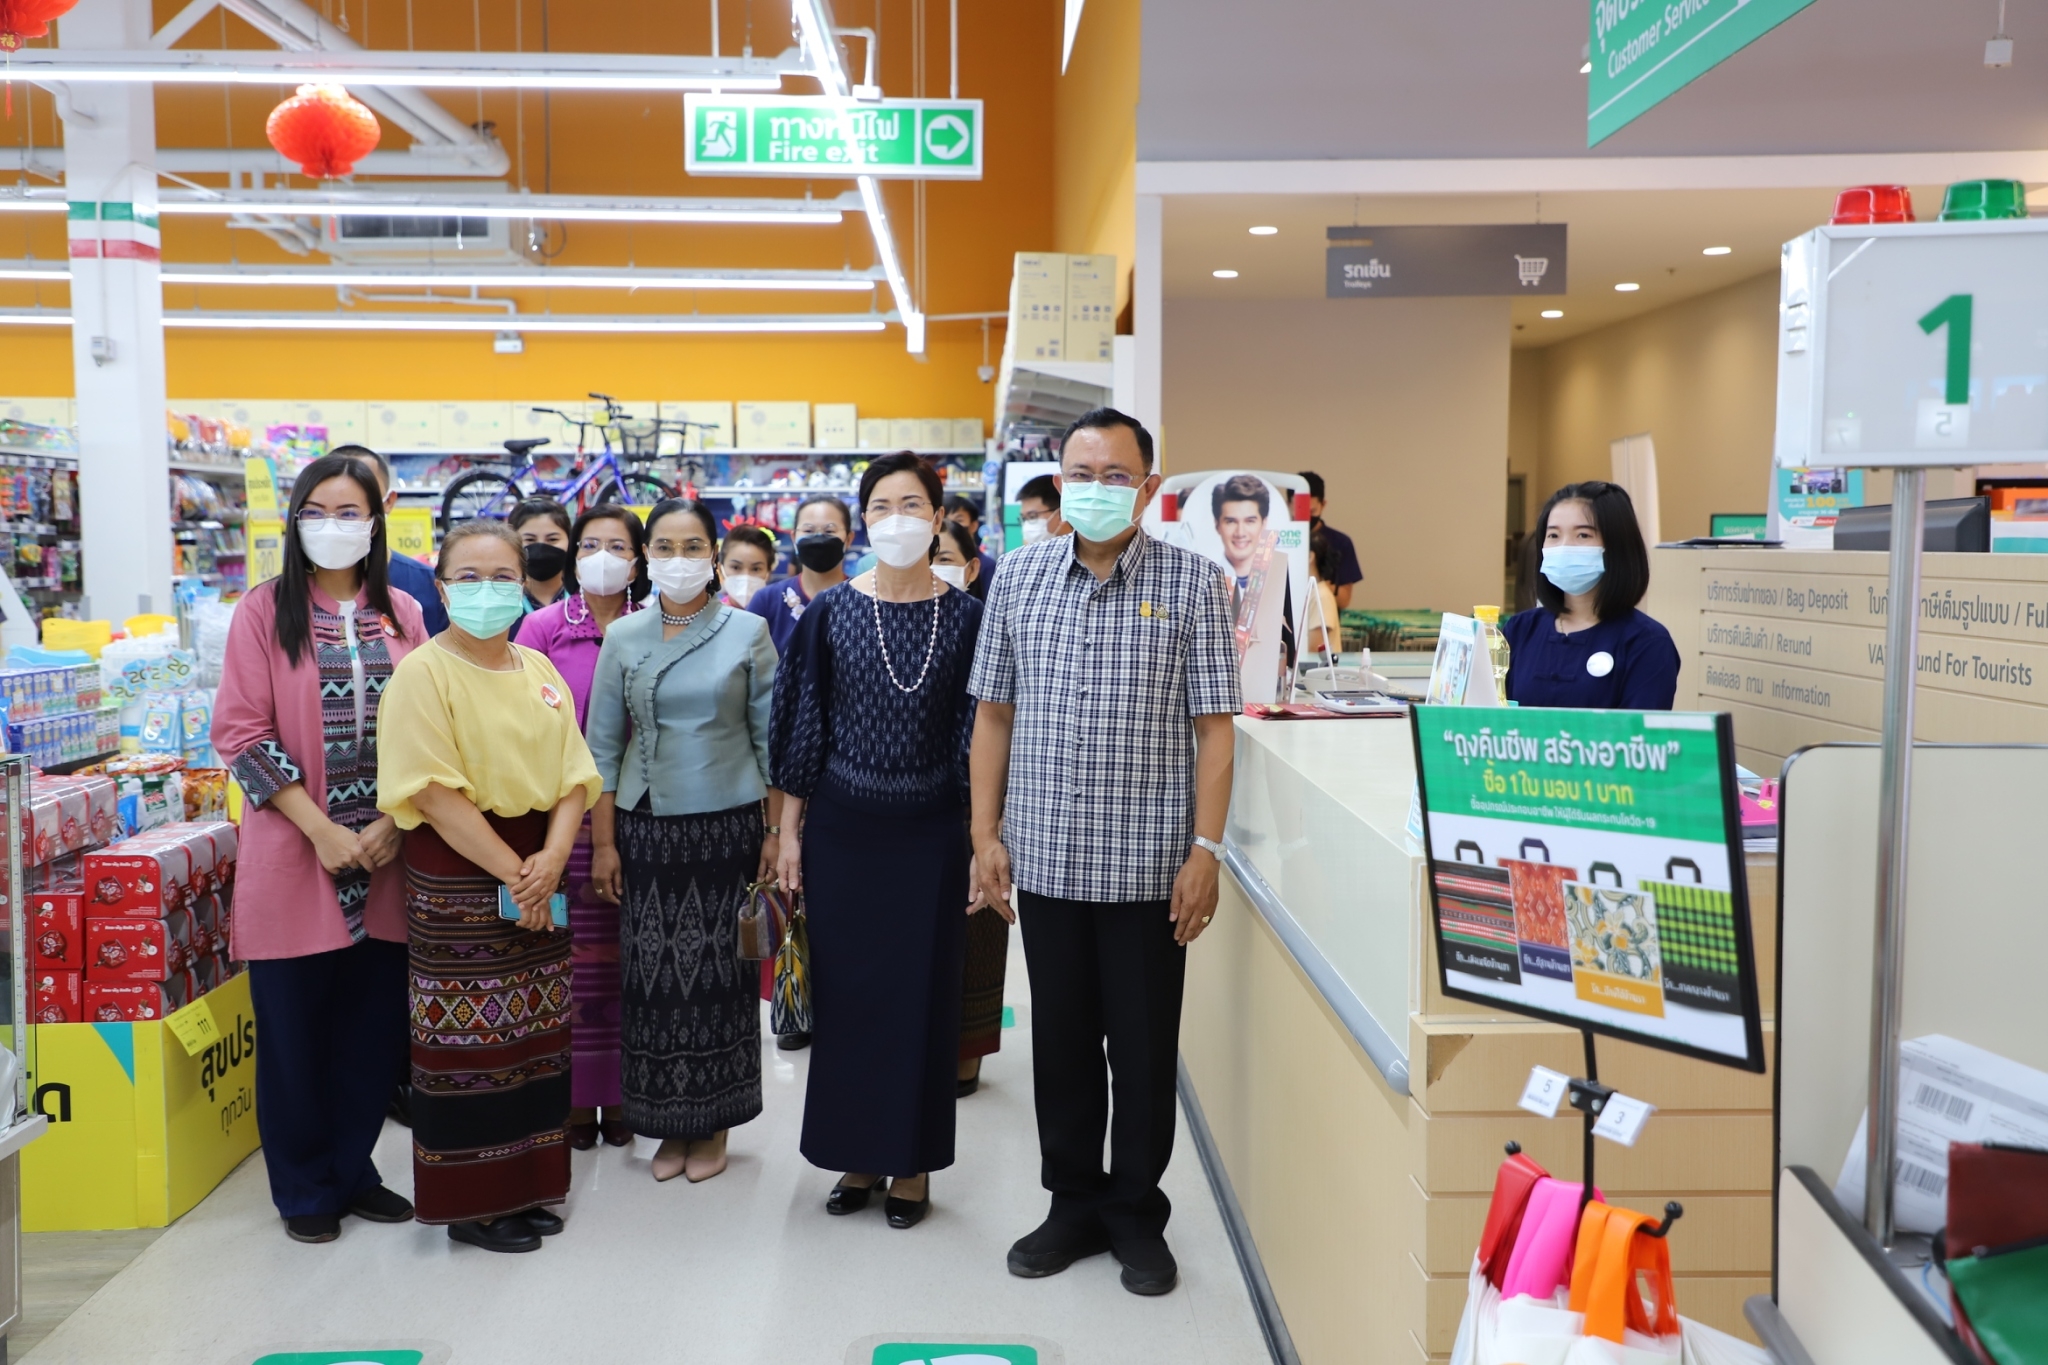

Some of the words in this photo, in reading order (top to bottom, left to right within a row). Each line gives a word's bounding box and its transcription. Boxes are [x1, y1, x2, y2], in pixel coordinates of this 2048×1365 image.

[1608, 19, 1662, 79] Customer
[769, 140, 819, 162] Fire
[825, 140, 879, 162] exit
[1343, 257, 1391, 278] รถเข็น
[1916, 293, 1973, 405] 1
[1806, 496, 1836, 508] 100
[397, 537, 422, 549] 100
[1280, 530, 1301, 538] one
[1281, 538, 1301, 548] stop
[1707, 580, 1778, 606] บริการรับฝากของ
[1786, 588, 1805, 613] Bag
[1808, 588, 1849, 613] Deposit
[1707, 622, 1768, 650] บริการคืนสินค้า
[167, 658, 190, 676] 20
[1868, 643, 1888, 666] VA
[1945, 652, 1968, 677] For
[1972, 655, 2033, 687] Tourists
[1772, 679, 1831, 708] Information
[1483, 759, 1506, 793] ซื้อ
[1510, 774, 1519, 796] 1
[1518, 770, 1539, 797] ใบ
[1543, 777, 1580, 800] มอบ
[1584, 779, 1593, 801] 1
[1597, 782, 1635, 806] บาท
[197, 1018, 212, 1035] 111
[1542, 1079, 1552, 1093] 5
[221, 1087, 252, 1137] ทุกวัน
[1614, 1111, 1625, 1124] 3
